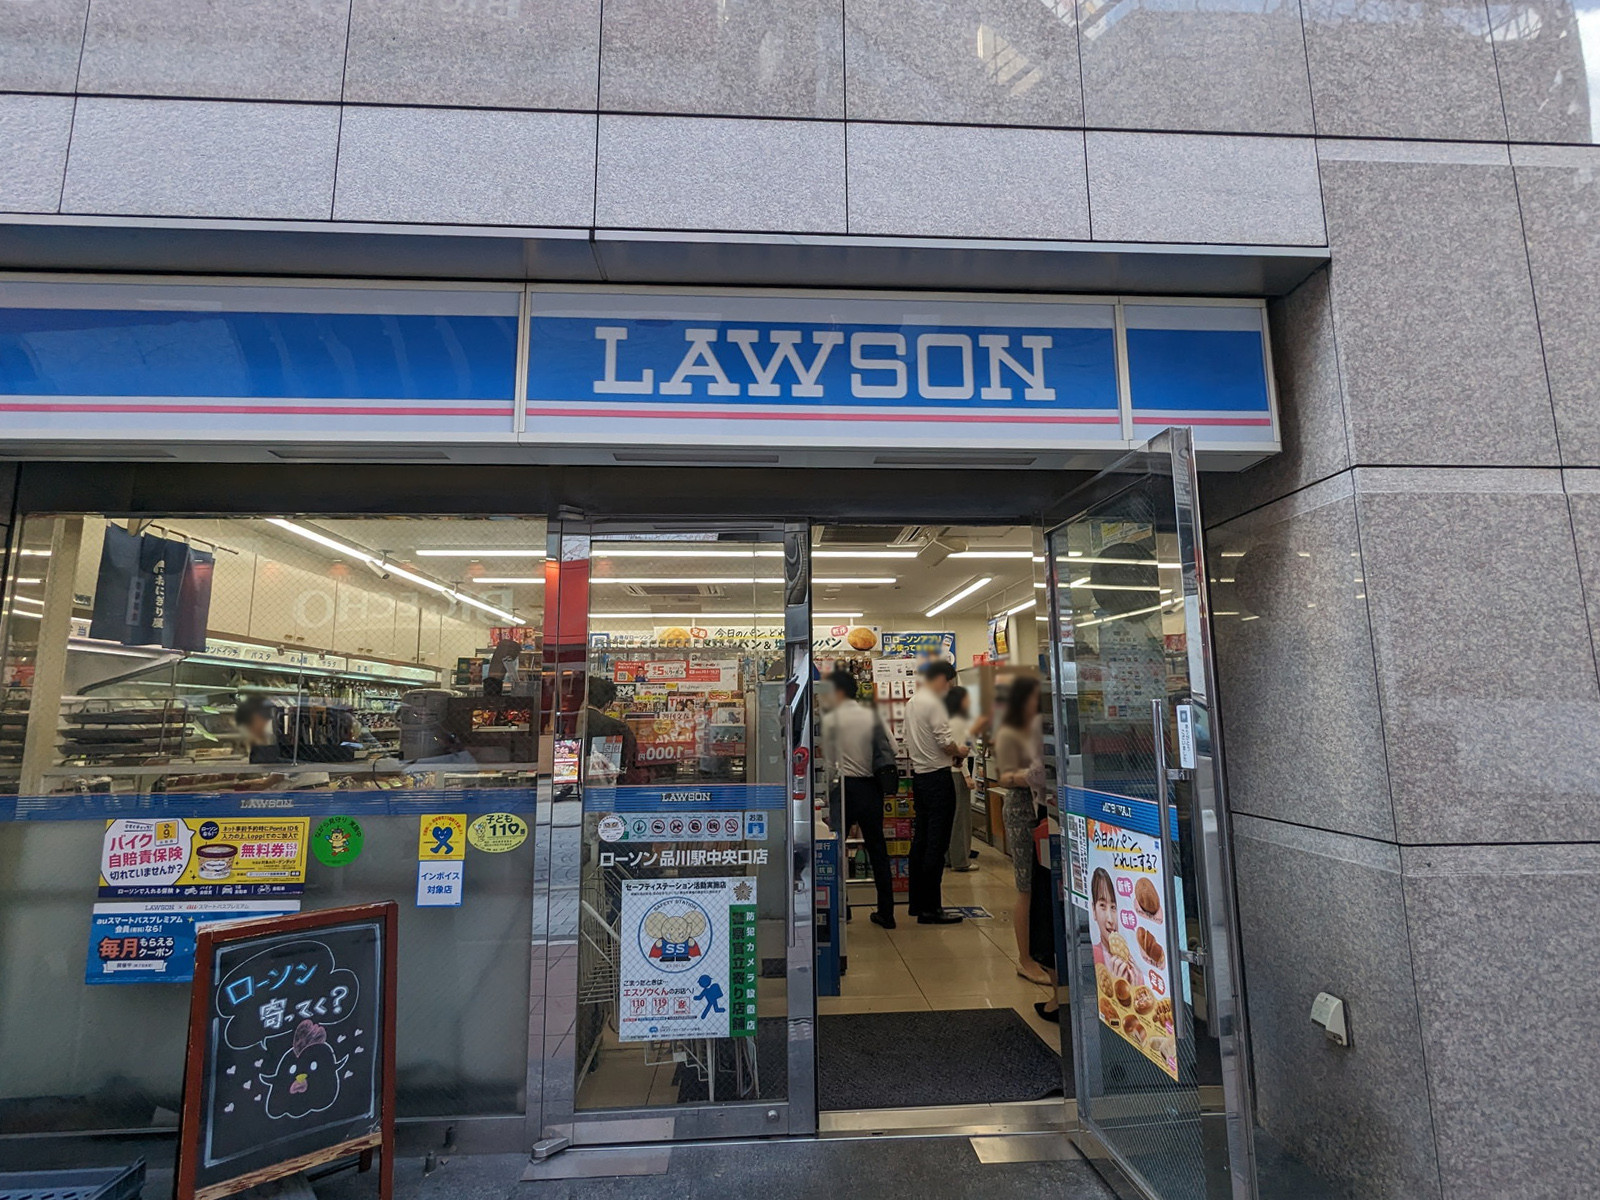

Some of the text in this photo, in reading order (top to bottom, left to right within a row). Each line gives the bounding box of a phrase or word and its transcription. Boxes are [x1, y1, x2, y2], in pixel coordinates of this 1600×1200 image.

[593, 326, 1056, 401] LAWSON
[240, 798, 294, 808] LAWSON
[661, 792, 712, 802] LAWSON
[486, 814, 513, 825] 子ども
[110, 833, 153, 851] バイク
[108, 846, 183, 868] 自賠責保険
[241, 843, 285, 858] 無料券
[600, 848, 768, 867] ローソン 品川駅中央口店
[1113, 853, 1158, 873] どれにする?
[109, 864, 183, 881] 切れていませんか?
[421, 872, 460, 880] インボイス
[427, 885, 453, 894] 対象店
[625, 881, 727, 891] セーフティステーション活動実施店
[653, 899, 698, 912] SAFETY STATION
[96, 916, 183, 925] auスマートパスプレミアム
[100, 938, 138, 959] 毎月
[139, 937, 174, 947] もらえる
[665, 943, 685, 954] SS
[138, 947, 173, 957] クーポン
[745, 911, 756, 1031] 防犯カメラ設置店
[225, 964, 318, 1005] ローソン
[623, 987, 695, 998] エスゾウくんのお店へ!
[259, 985, 349, 1029] 寄ってく?
